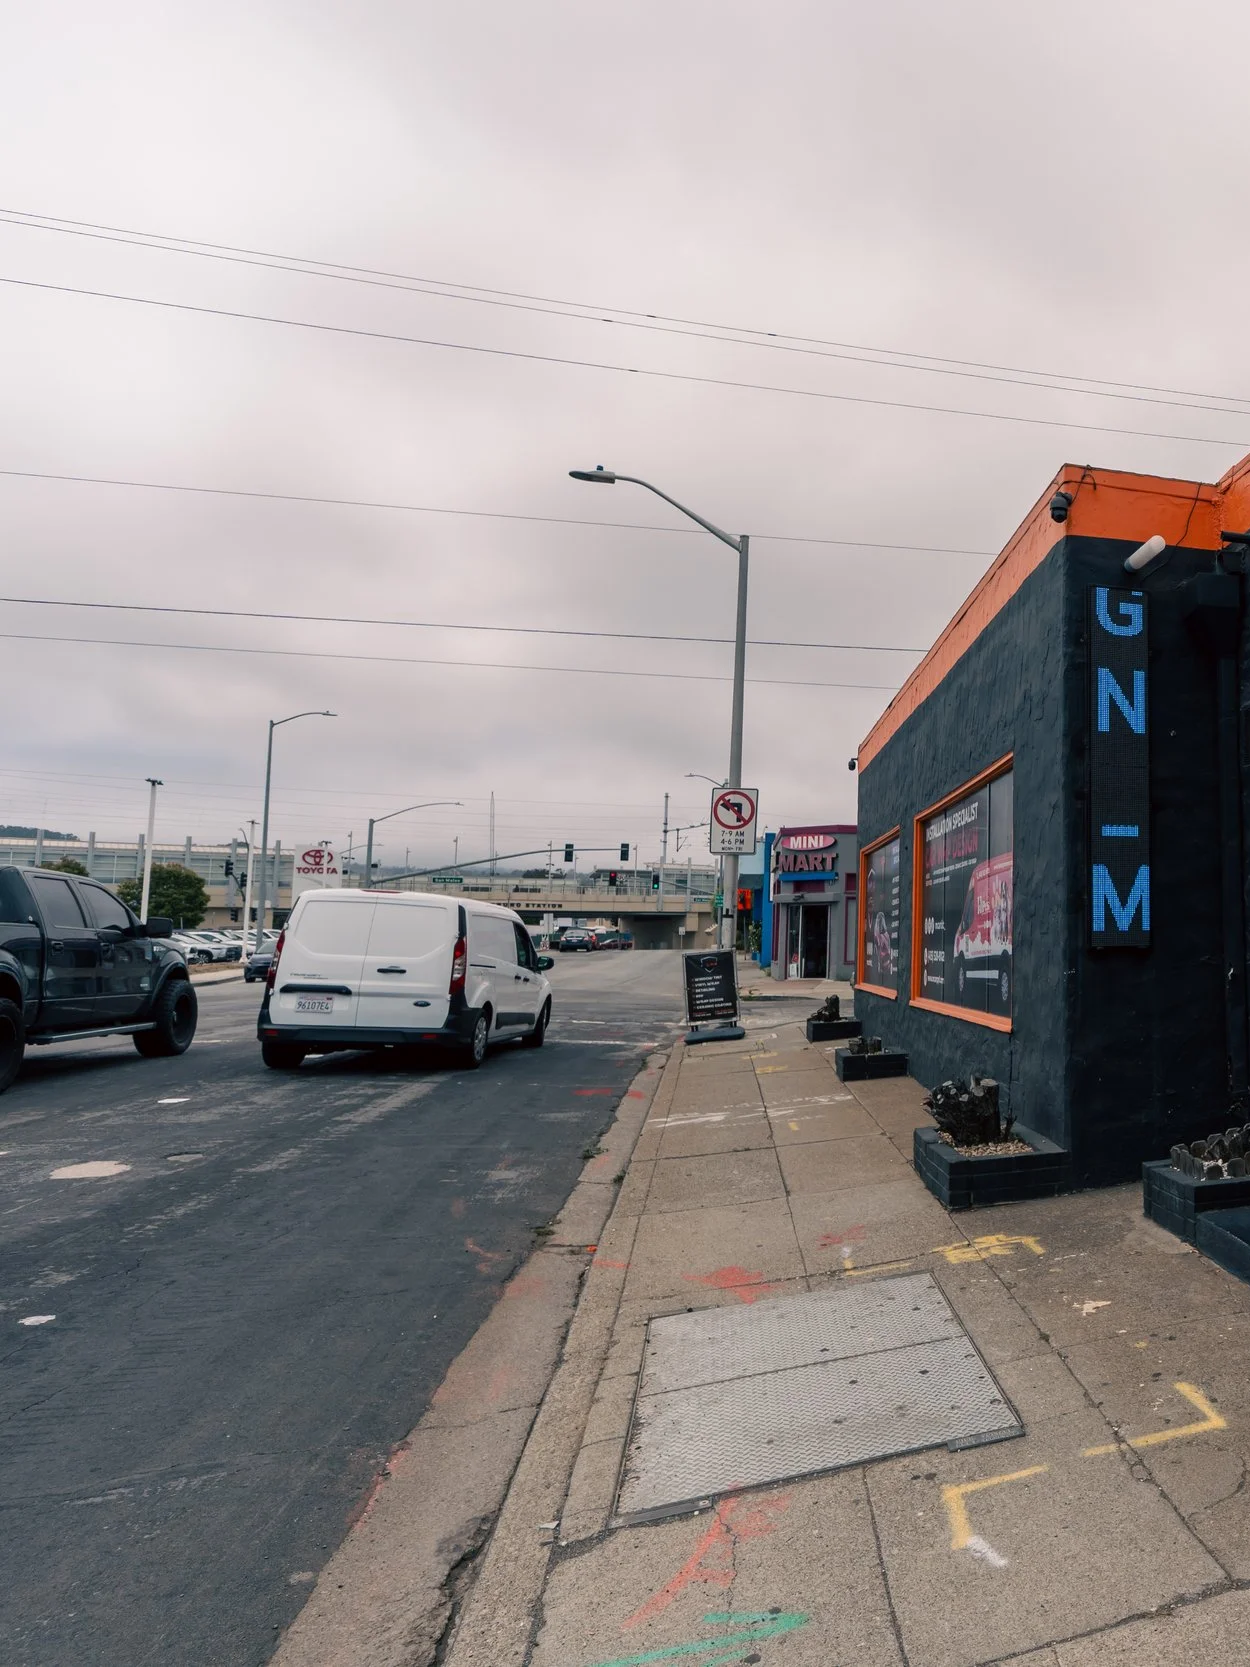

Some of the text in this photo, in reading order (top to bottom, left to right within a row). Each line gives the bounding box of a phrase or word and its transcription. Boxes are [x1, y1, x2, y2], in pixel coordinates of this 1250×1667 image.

[952, 801, 979, 830] SPECIALIST
[790, 835, 824, 849] MINI
[778, 852, 837, 872] MART
[296, 866, 338, 874] TOYOTA
[296, 1001, 330, 1011] 96107E4
